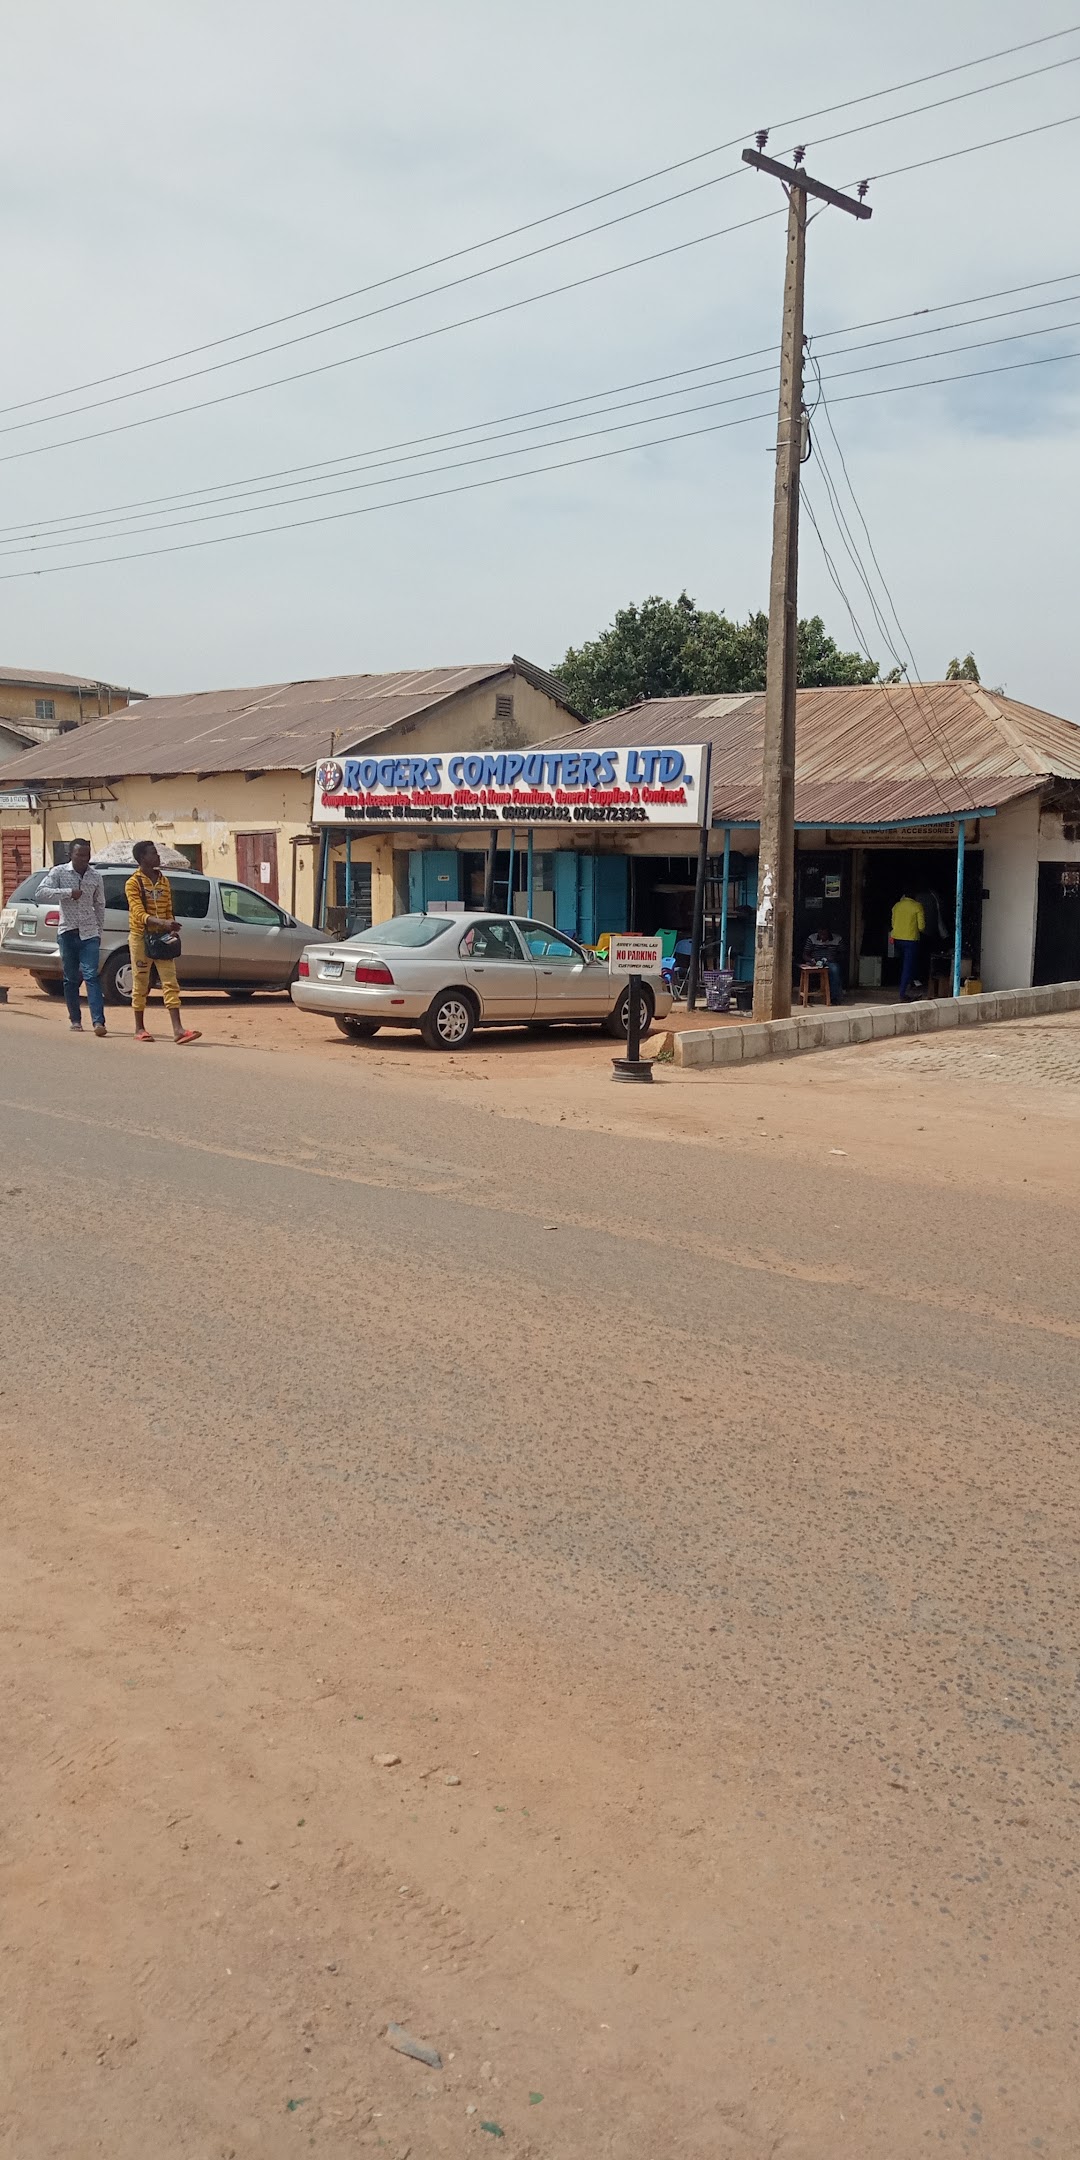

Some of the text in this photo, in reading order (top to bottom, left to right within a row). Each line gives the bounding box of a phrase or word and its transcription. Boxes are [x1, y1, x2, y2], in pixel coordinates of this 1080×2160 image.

[344, 757, 443, 791] ROGERS
[448, 751, 619, 787] COMPUTERS
[626, 749, 693, 784] LTD.
[321, 792, 358, 809] Computers
[359, 791, 365, 806] &
[454, 789, 479, 805] Office
[479, 789, 487, 805] &
[487, 789, 512, 805] Home
[512, 788, 554, 805] Furniture,
[555, 788, 590, 804] General
[589, 787, 630, 807] Supplies
[631, 787, 640, 803] &
[454, 806, 481, 819] Street
[617, 950, 657, 961] NO PARKING
